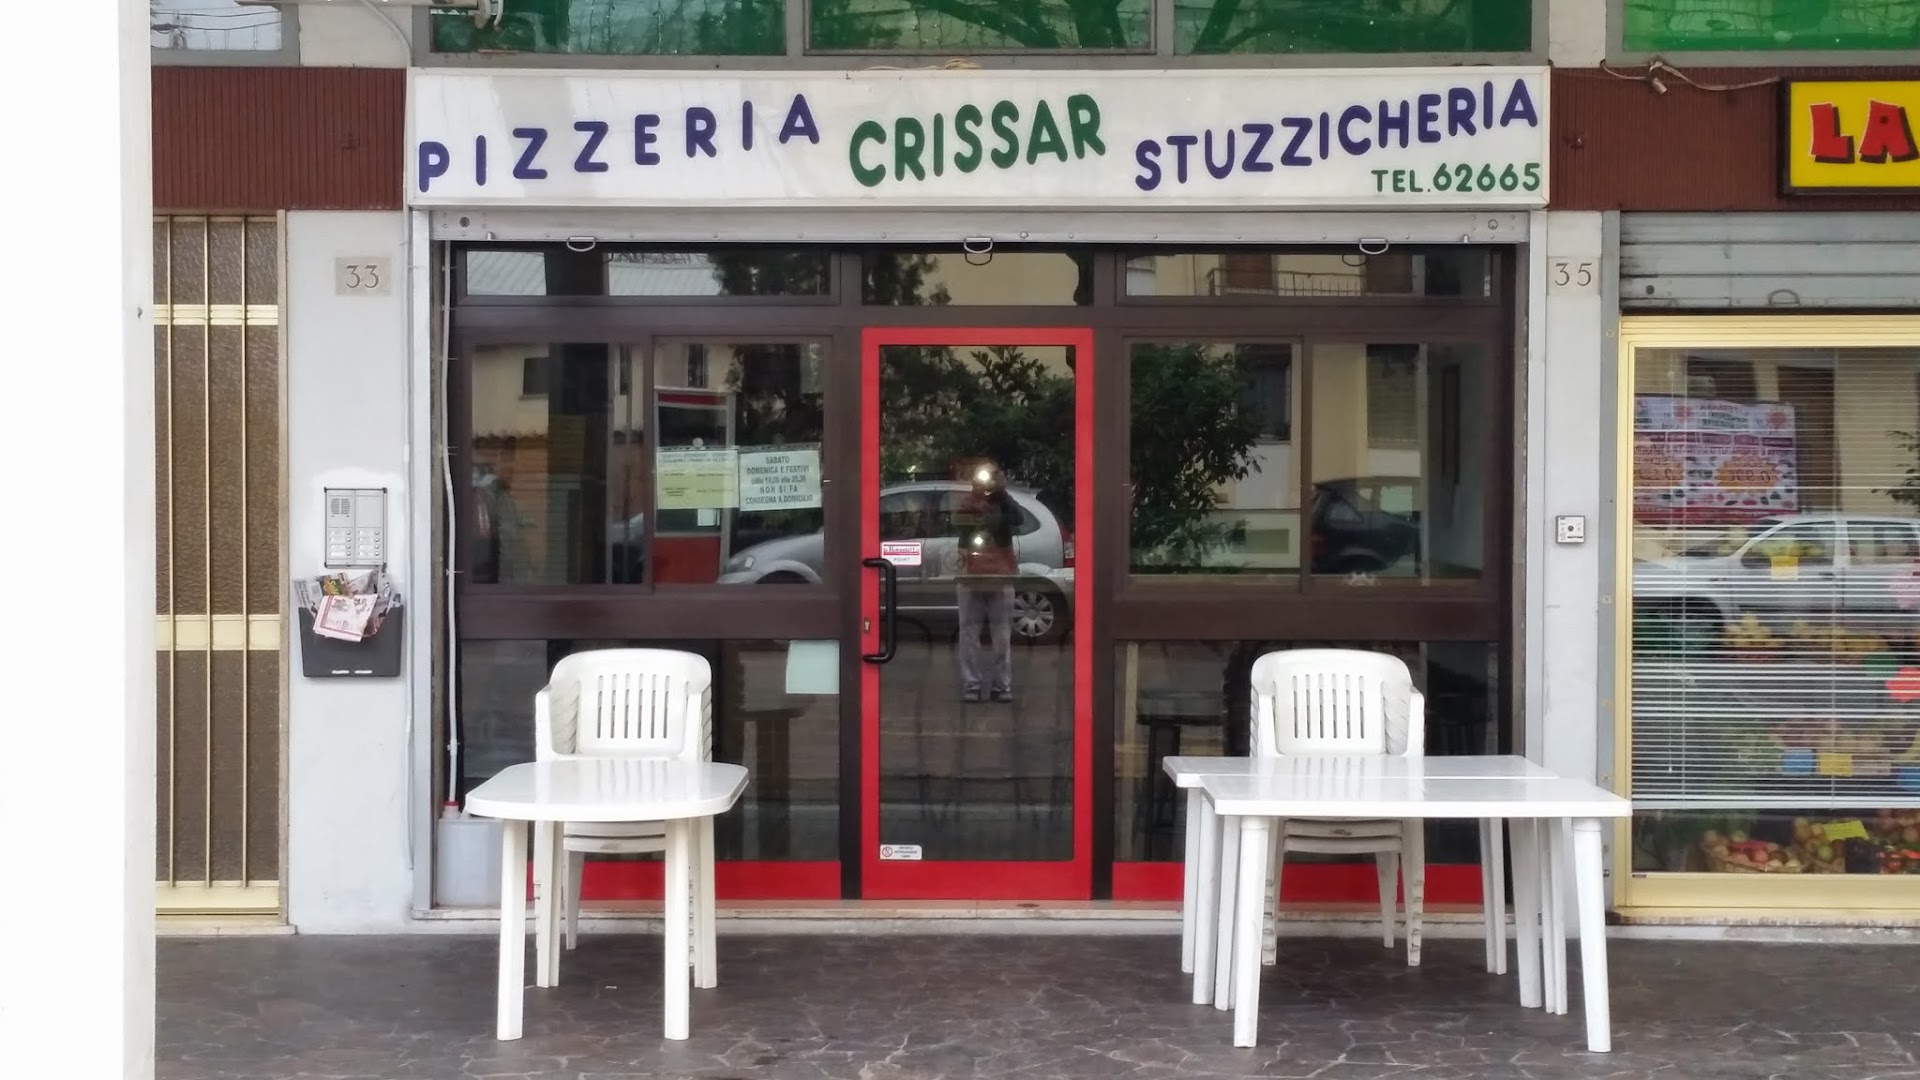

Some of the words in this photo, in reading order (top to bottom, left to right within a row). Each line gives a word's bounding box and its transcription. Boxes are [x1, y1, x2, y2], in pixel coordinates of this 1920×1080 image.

[418, 93, 820, 193] PIZZERIA
[849, 93, 1106, 188] CRISSAR
[1135, 78, 1539, 192] STUZZICHERIA
[1808, 98, 1920, 165] LA
[346, 264, 380, 289] 33
[1554, 262, 1593, 287] 35
[765, 455, 790, 464] SABATO
[746, 466, 779, 475] DOMENICA
[780, 466, 785, 474] E
[786, 465, 810, 473] FESTIVI
[760, 486, 776, 494] NON
[779, 485, 787, 493] SI
[789, 484, 798, 492] FA
[745, 496, 777, 504] CONSEGNA
[783, 494, 814, 503] DOMICILIO
